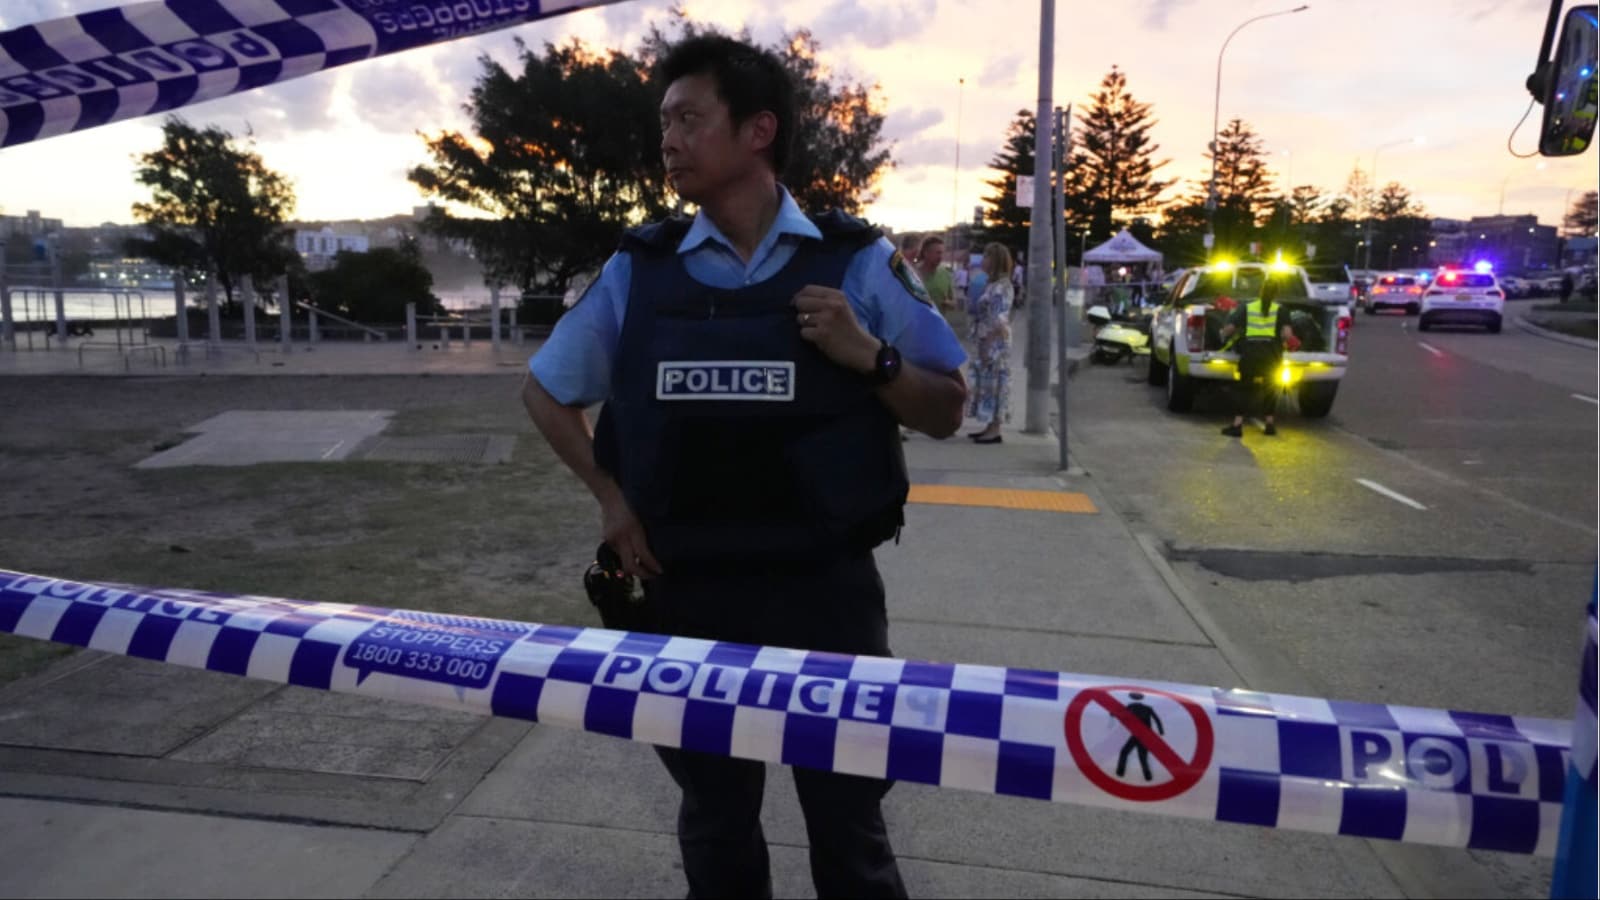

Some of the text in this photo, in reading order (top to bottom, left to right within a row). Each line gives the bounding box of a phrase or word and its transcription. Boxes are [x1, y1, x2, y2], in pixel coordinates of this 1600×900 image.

[5, 31, 268, 96] POLICE
[664, 369, 786, 392] POLICE
[370, 627, 504, 654] STOPPERS
[352, 643, 487, 680] 1800 333 000
[603, 654, 883, 721] POLICE
